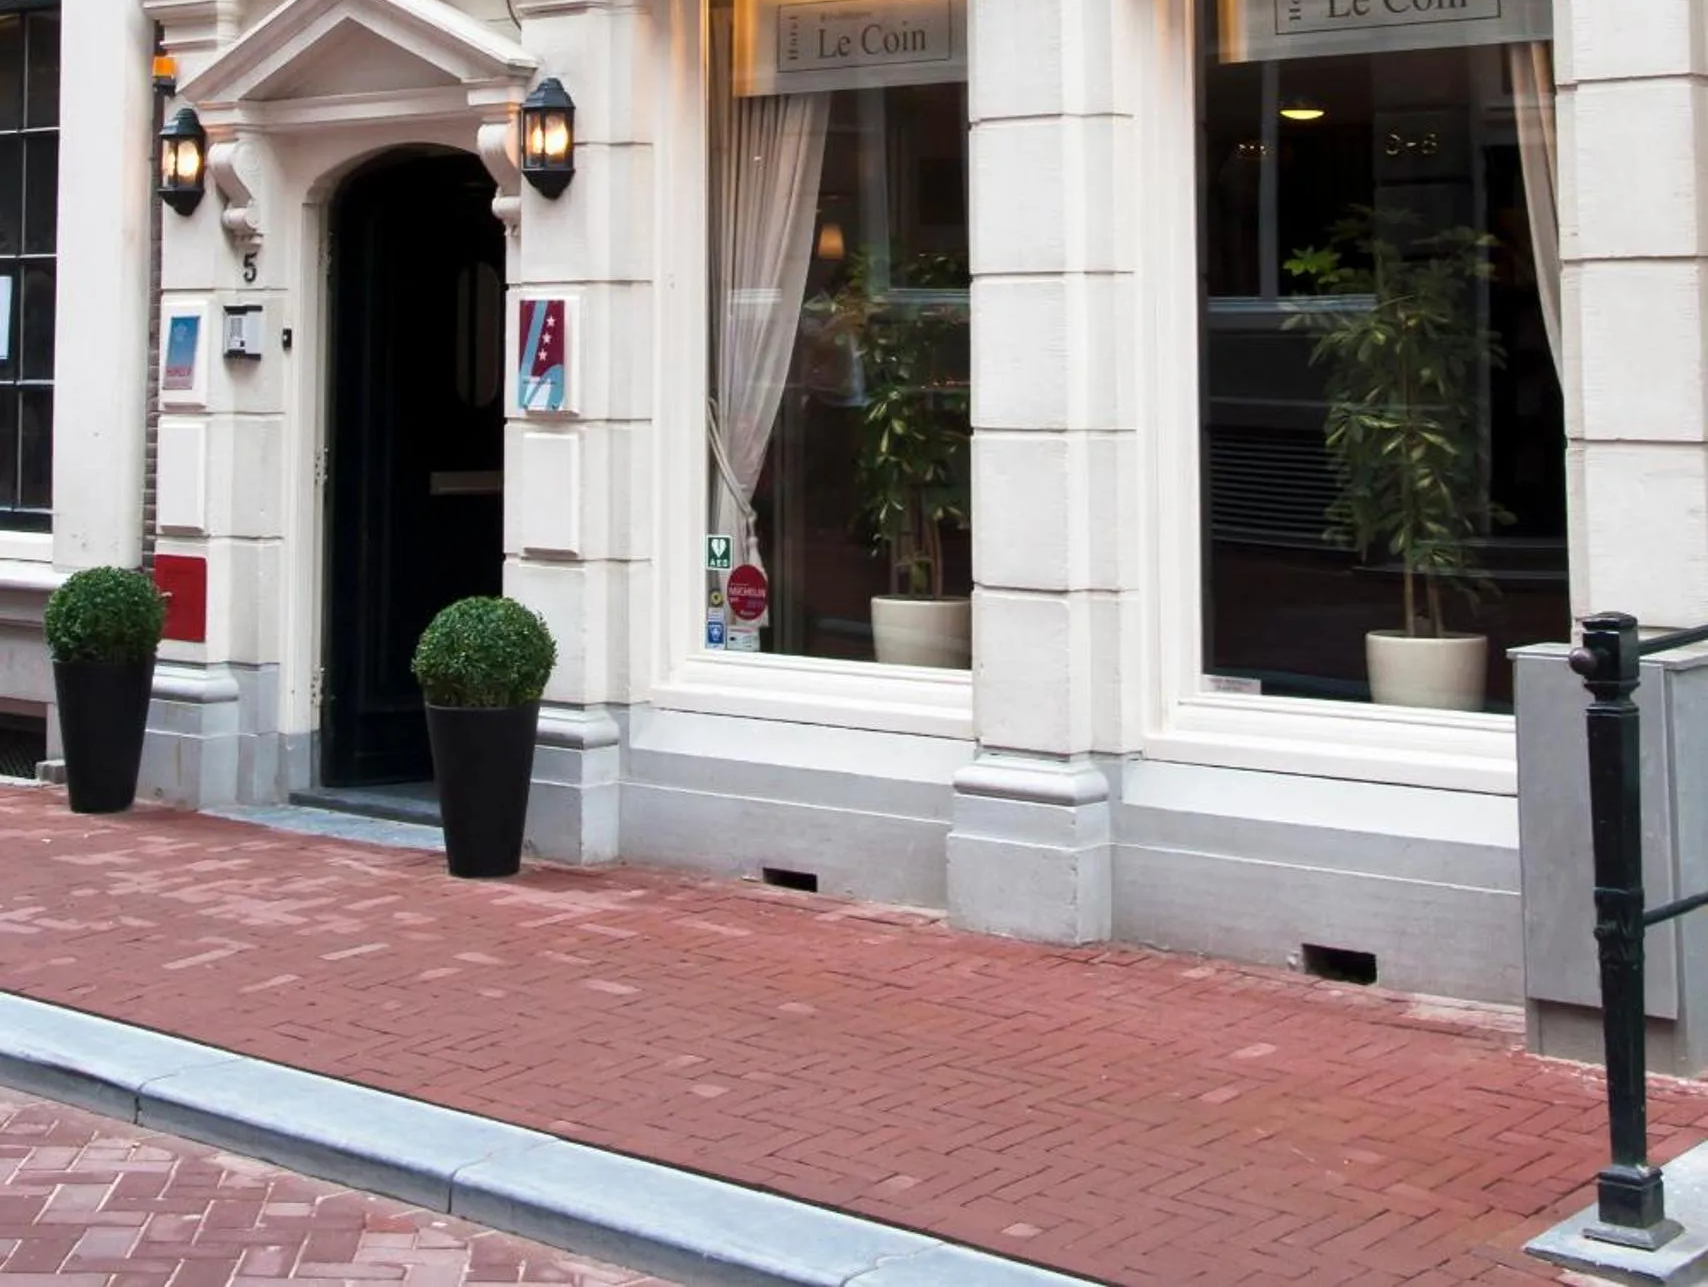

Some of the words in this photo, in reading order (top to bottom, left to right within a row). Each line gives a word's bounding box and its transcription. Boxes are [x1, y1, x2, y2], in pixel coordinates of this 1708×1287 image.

[817, 28, 851, 59] Le
[861, 20, 926, 55] Coin
[244, 252, 257, 283] 5
